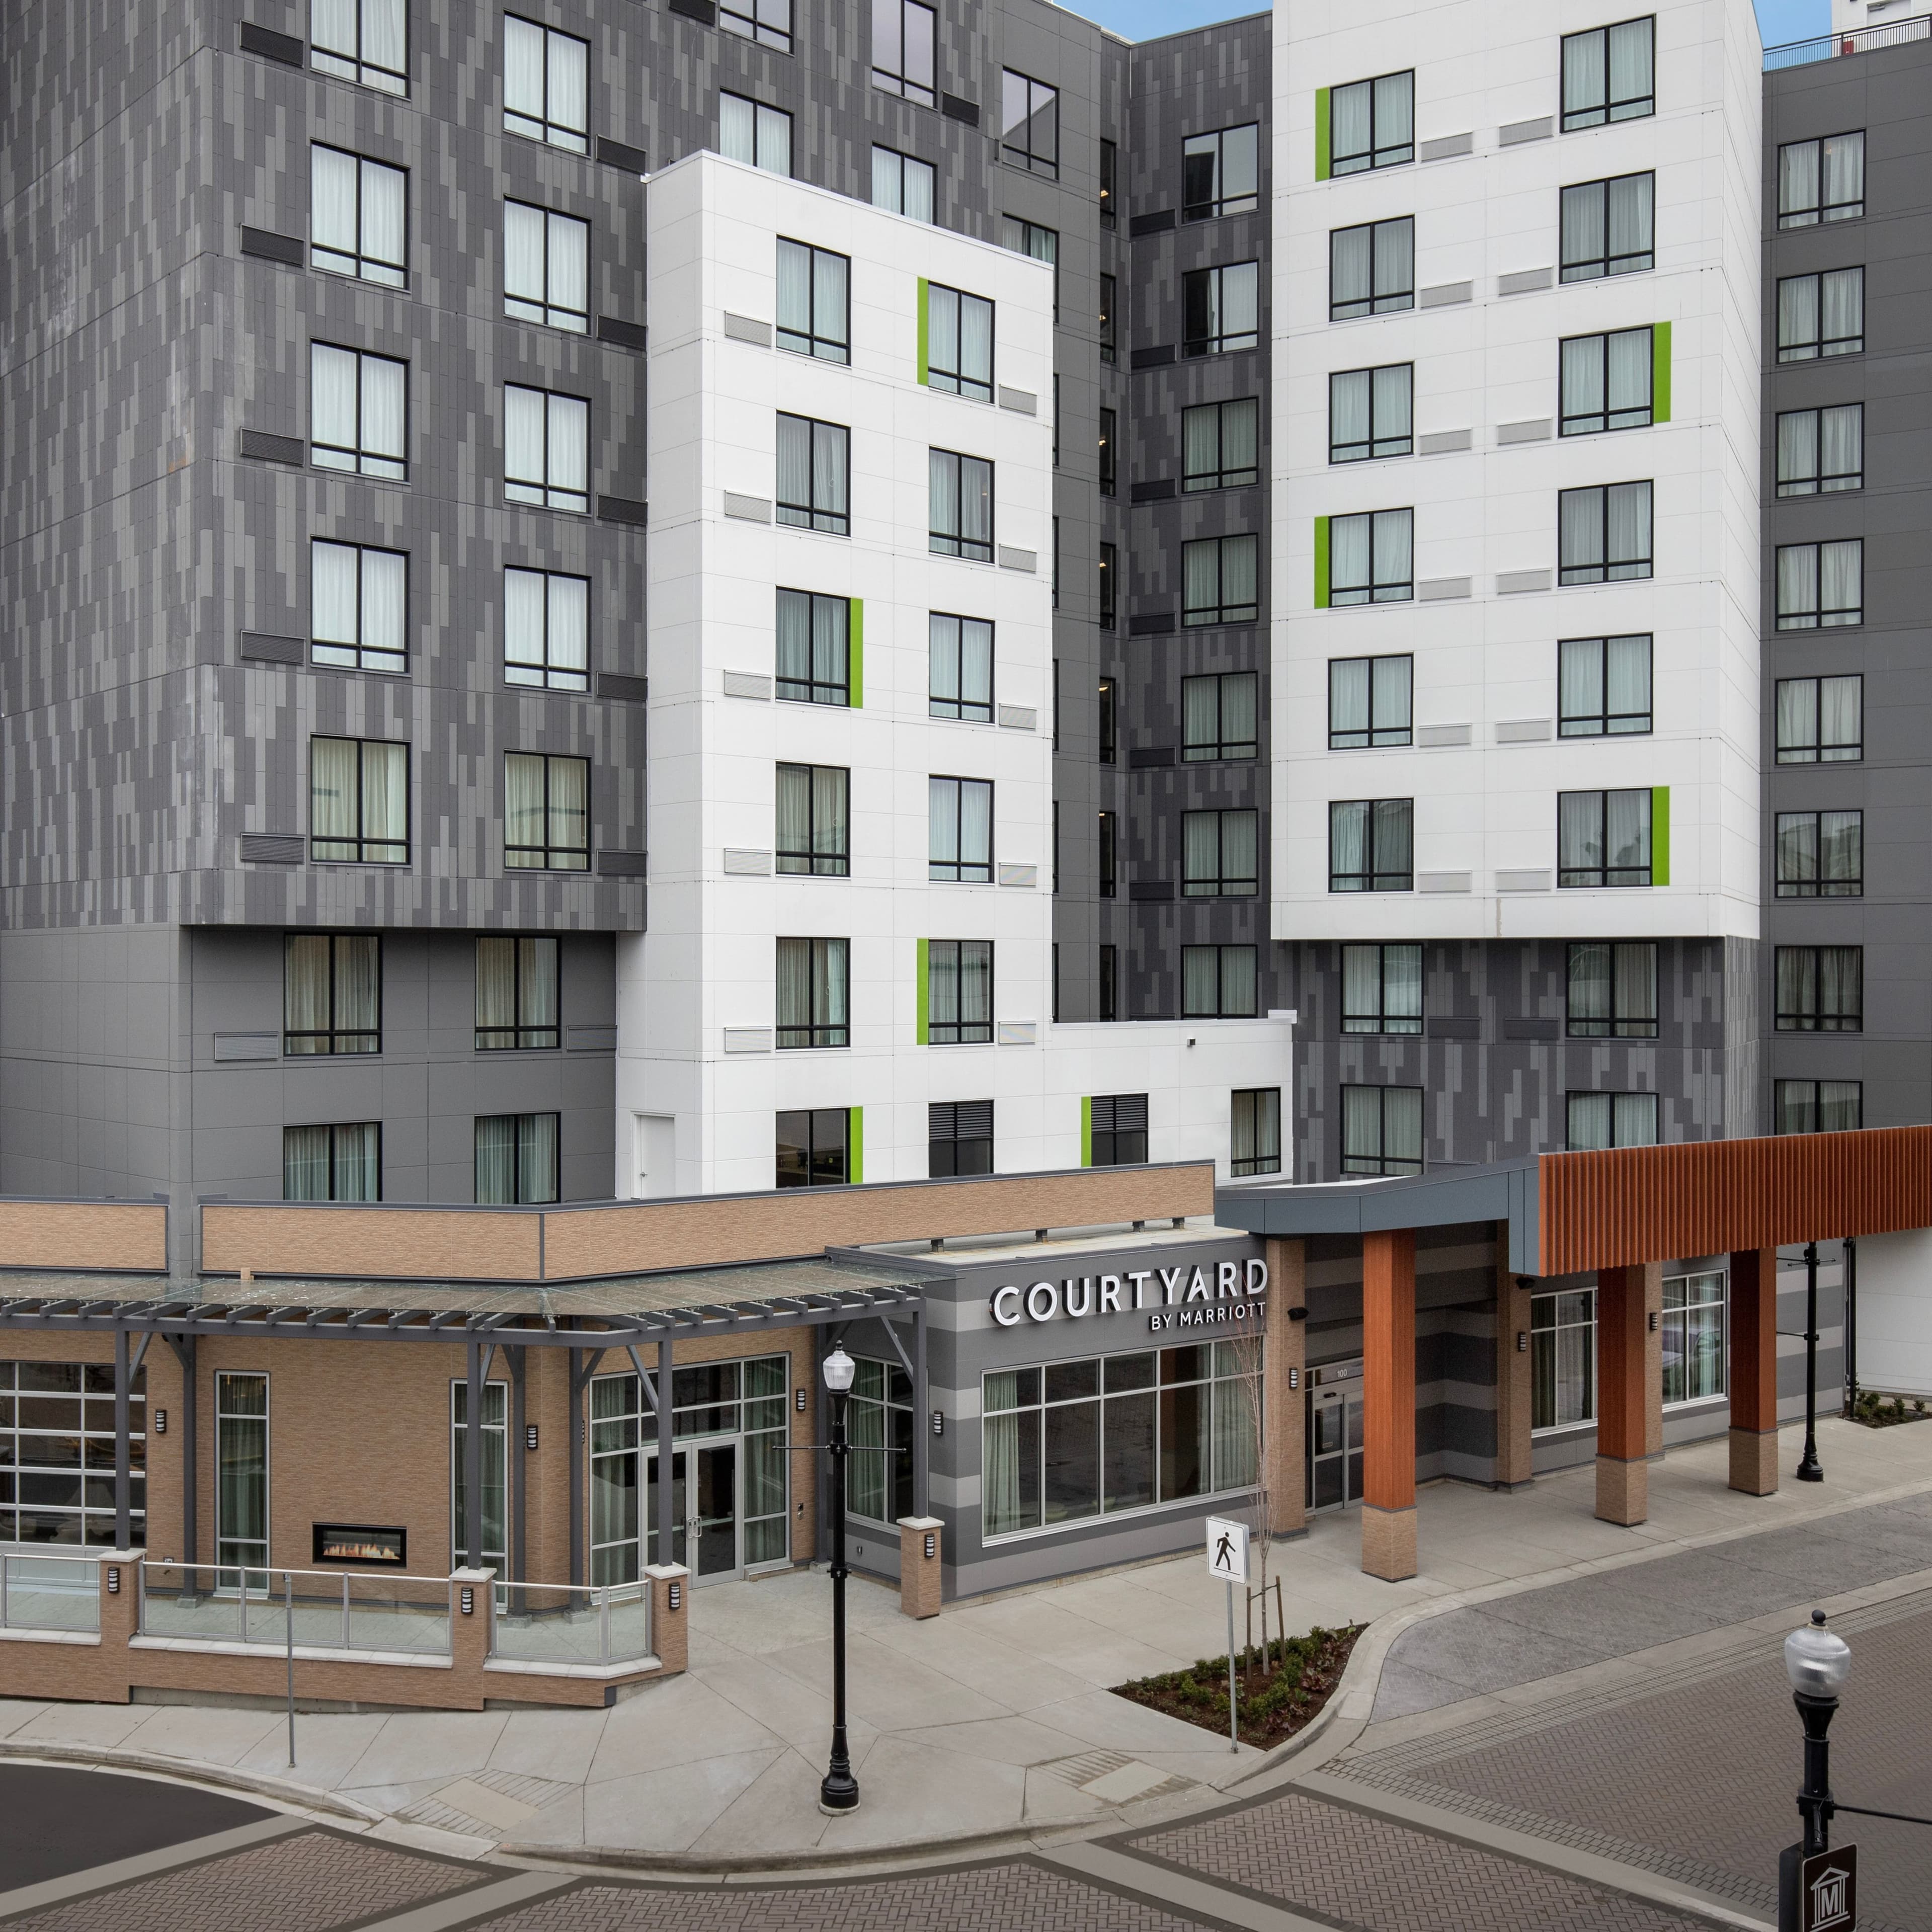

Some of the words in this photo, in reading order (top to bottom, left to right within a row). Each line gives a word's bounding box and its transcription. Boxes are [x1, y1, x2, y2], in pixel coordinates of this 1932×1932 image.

[990, 1258, 1268, 1326] COURTYARD
[1150, 1313, 1172, 1331] BY
[1179, 1301, 1266, 1326] MARRIOTT
[1337, 1369, 1347, 1378] 100
[1821, 1883, 1838, 1918] M
